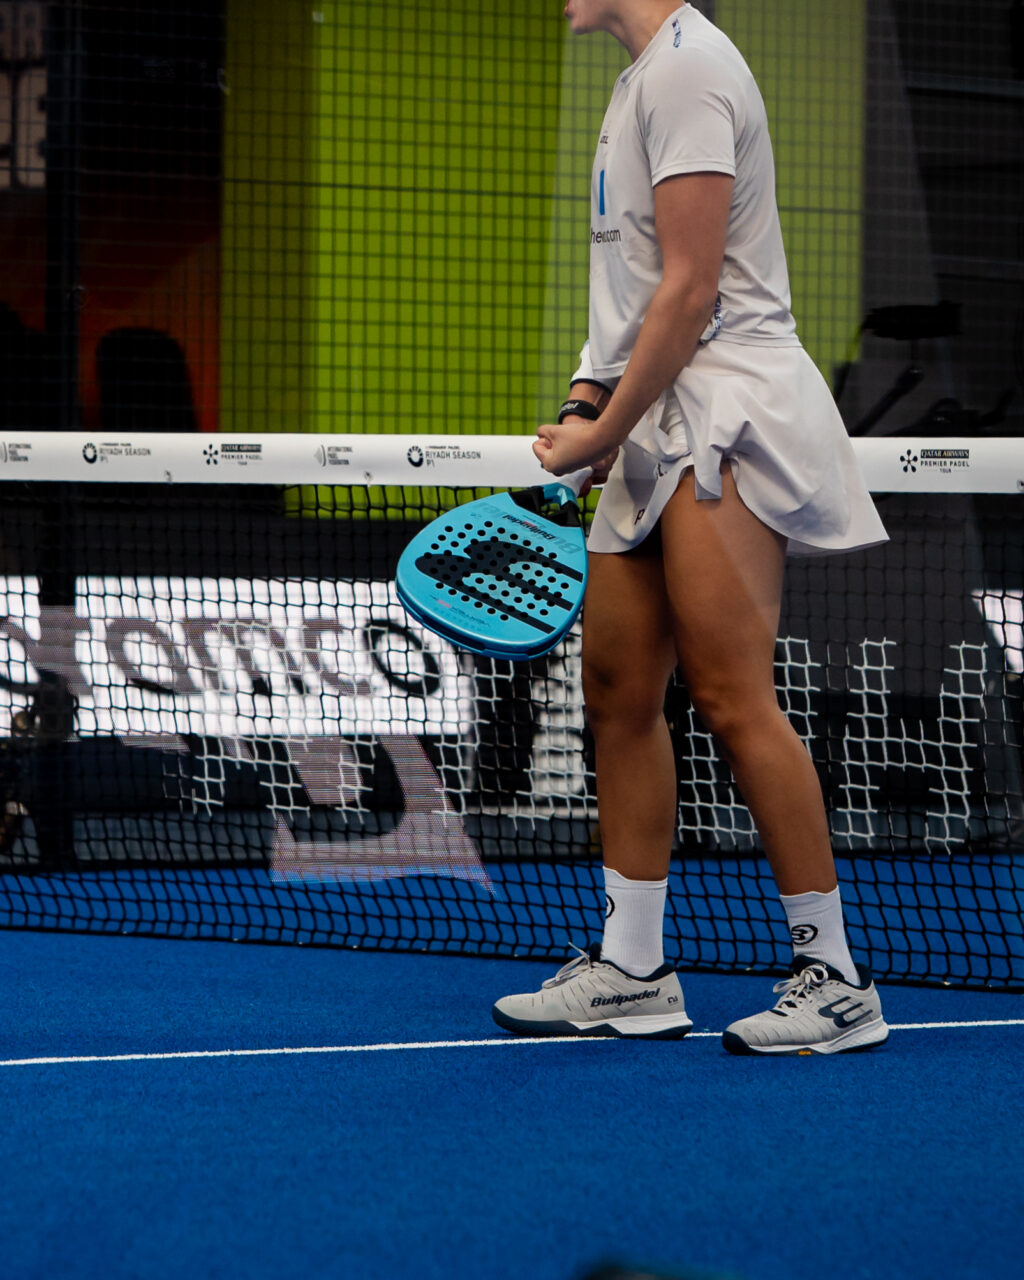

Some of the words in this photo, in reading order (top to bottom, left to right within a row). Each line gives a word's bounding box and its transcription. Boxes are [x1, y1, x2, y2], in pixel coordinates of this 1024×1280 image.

[98, 448, 123, 456] RIYADH
[124, 448, 152, 456] SEASON
[425, 450, 451, 459] RIYADH
[452, 450, 481, 460] SEASON
[921, 450, 942, 458] QATAR
[949, 460, 970, 468] PADEL
[590, 987, 661, 1008] Bullpadel
